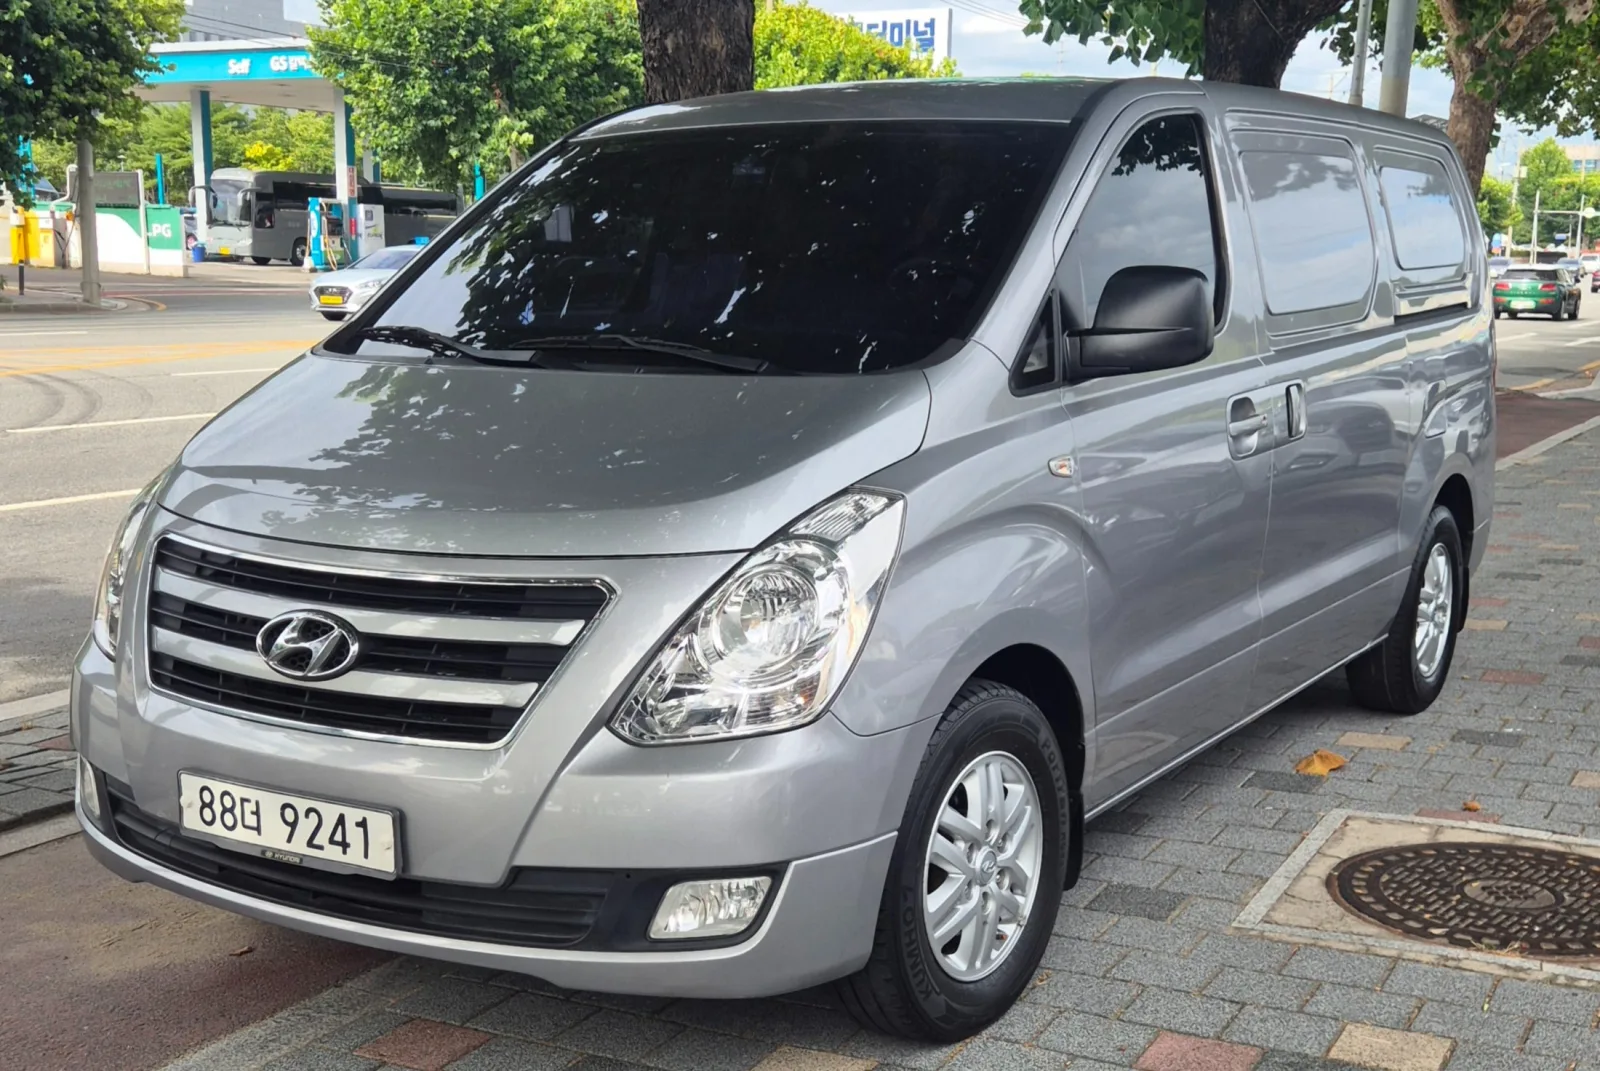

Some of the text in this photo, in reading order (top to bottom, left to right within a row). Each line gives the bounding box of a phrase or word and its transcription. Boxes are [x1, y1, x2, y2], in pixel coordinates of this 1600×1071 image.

[228, 58, 251, 75] Self
[198, 784, 370, 860] 88더 9241
[902, 908, 934, 1002] KUMHO
